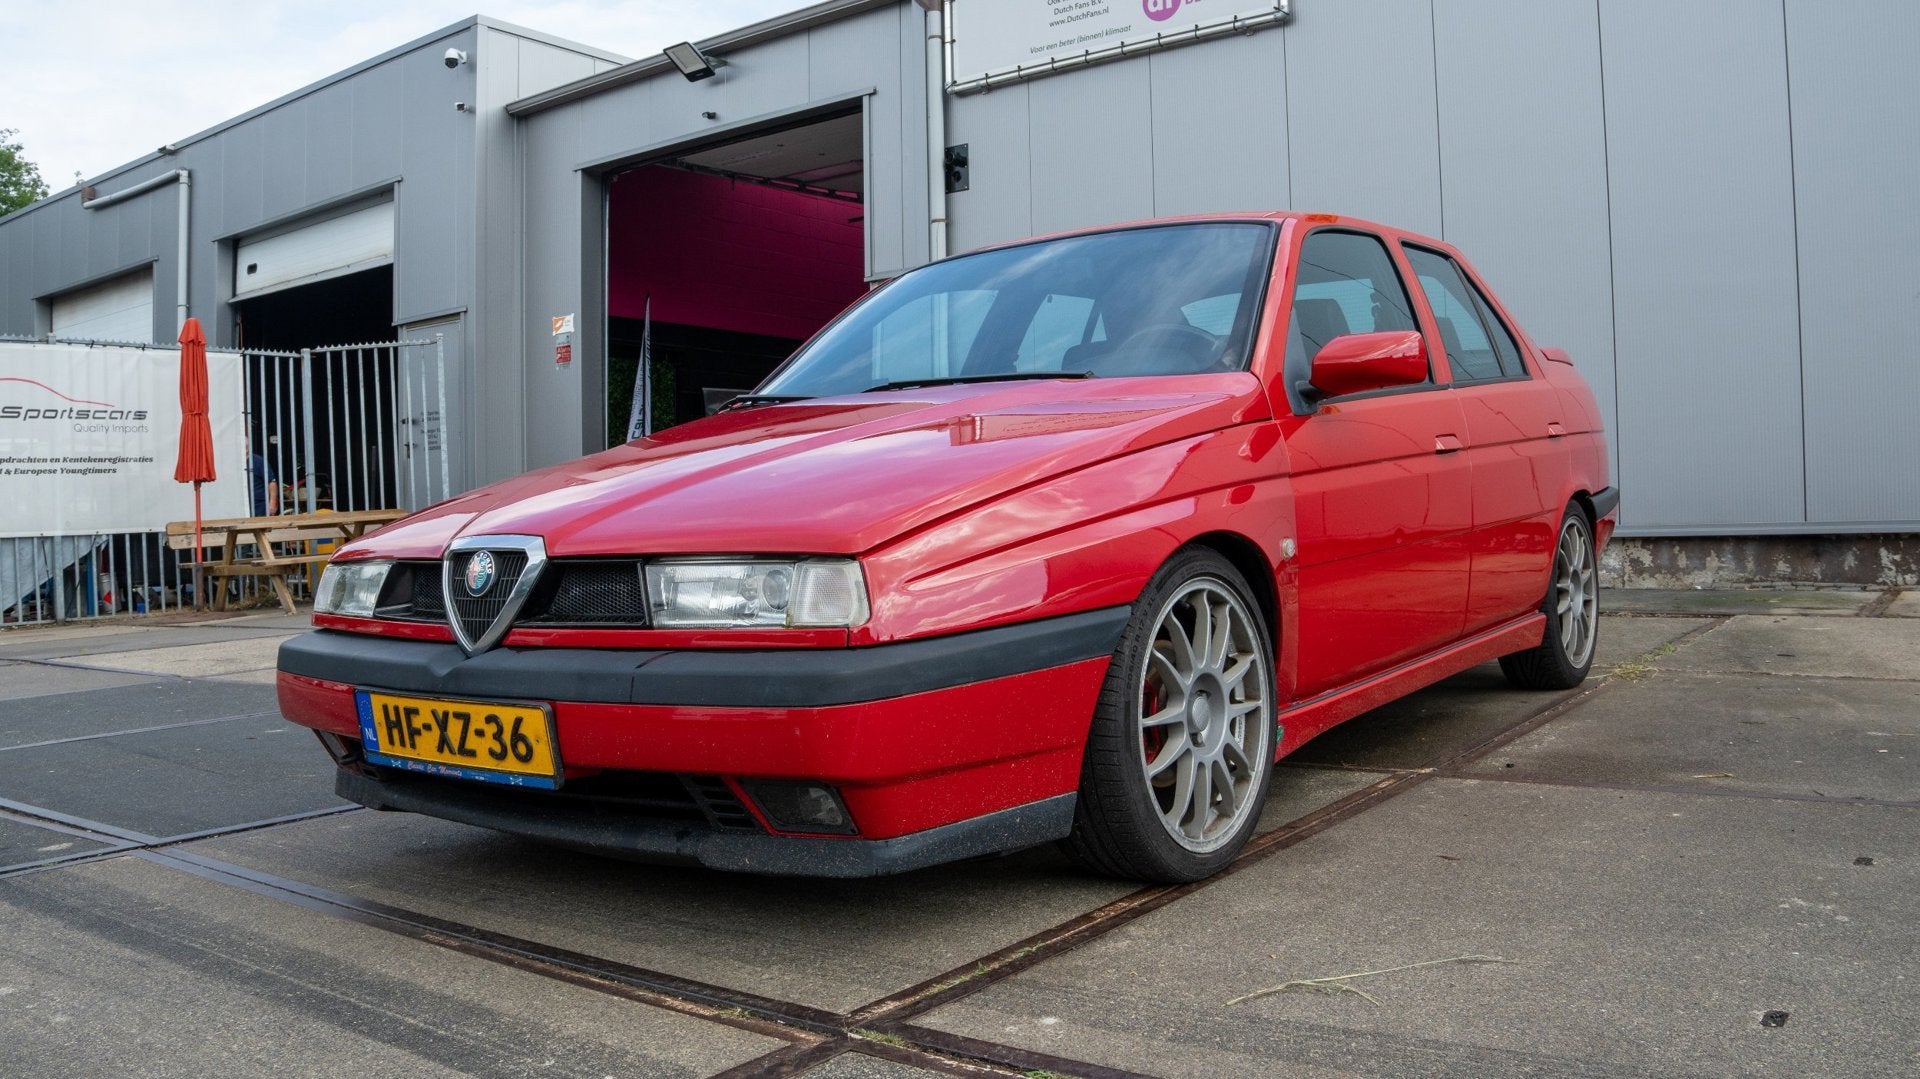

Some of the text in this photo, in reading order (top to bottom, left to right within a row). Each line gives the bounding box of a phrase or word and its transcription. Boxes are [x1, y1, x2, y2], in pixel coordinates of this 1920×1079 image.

[1053, 4, 1074, 16] Dutch
[1074, 1, 1090, 10] Fans
[1049, 6, 1110, 28] www.DutchFans.nl
[1030, 24, 1132, 54] Voor een beter (binnen) klimaat
[0, 406, 148, 421] Sportscars
[73, 423, 149, 434] Quality Imports
[62, 455, 154, 464] Kentekenregistraties
[14, 467, 58, 476] Europese
[60, 467, 117, 475] Youngtimers
[365, 727, 377, 741] NL
[382, 703, 534, 763] HF-XZ-36
